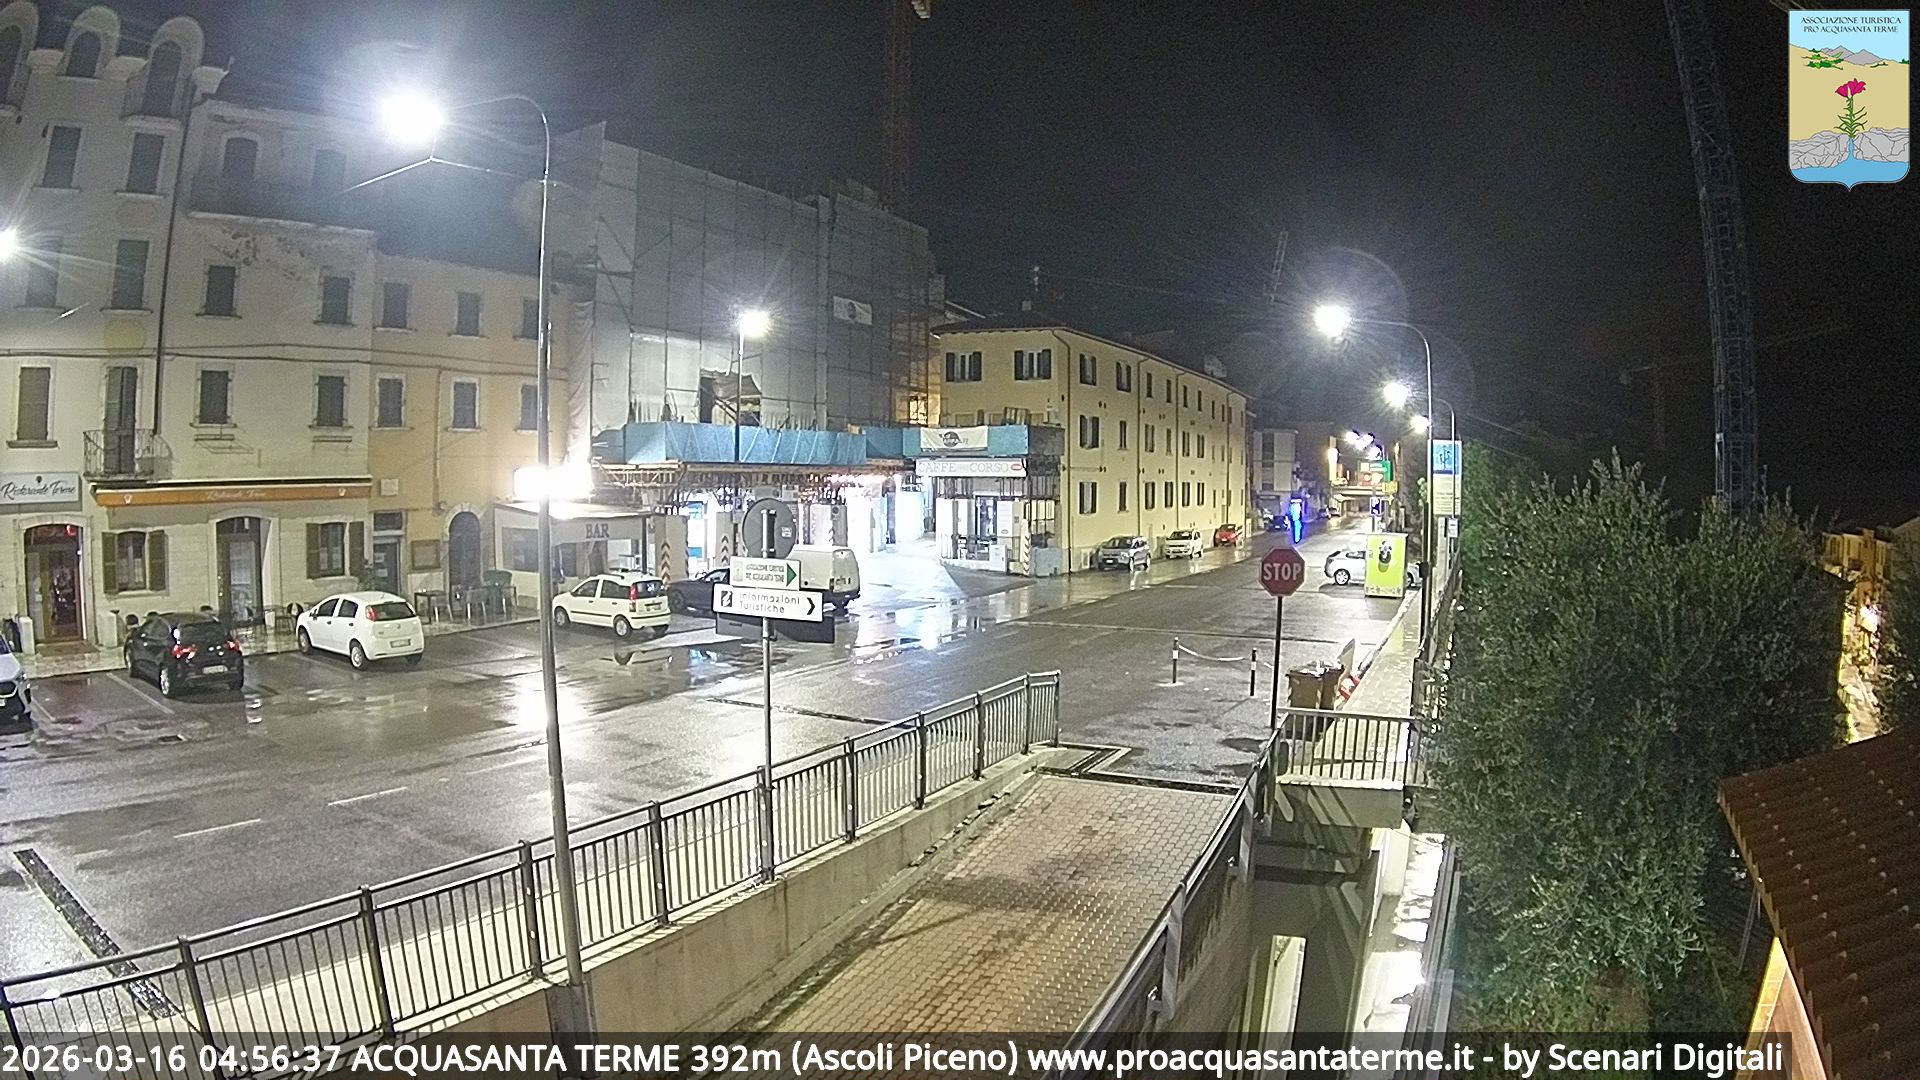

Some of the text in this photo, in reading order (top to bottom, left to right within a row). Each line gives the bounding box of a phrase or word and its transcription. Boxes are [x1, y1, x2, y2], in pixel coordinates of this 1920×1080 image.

[969, 462, 1009, 473] CORSO
[585, 523, 610, 539] BAR
[1263, 562, 1302, 581] STOP
[739, 600, 785, 613] Turistiche
